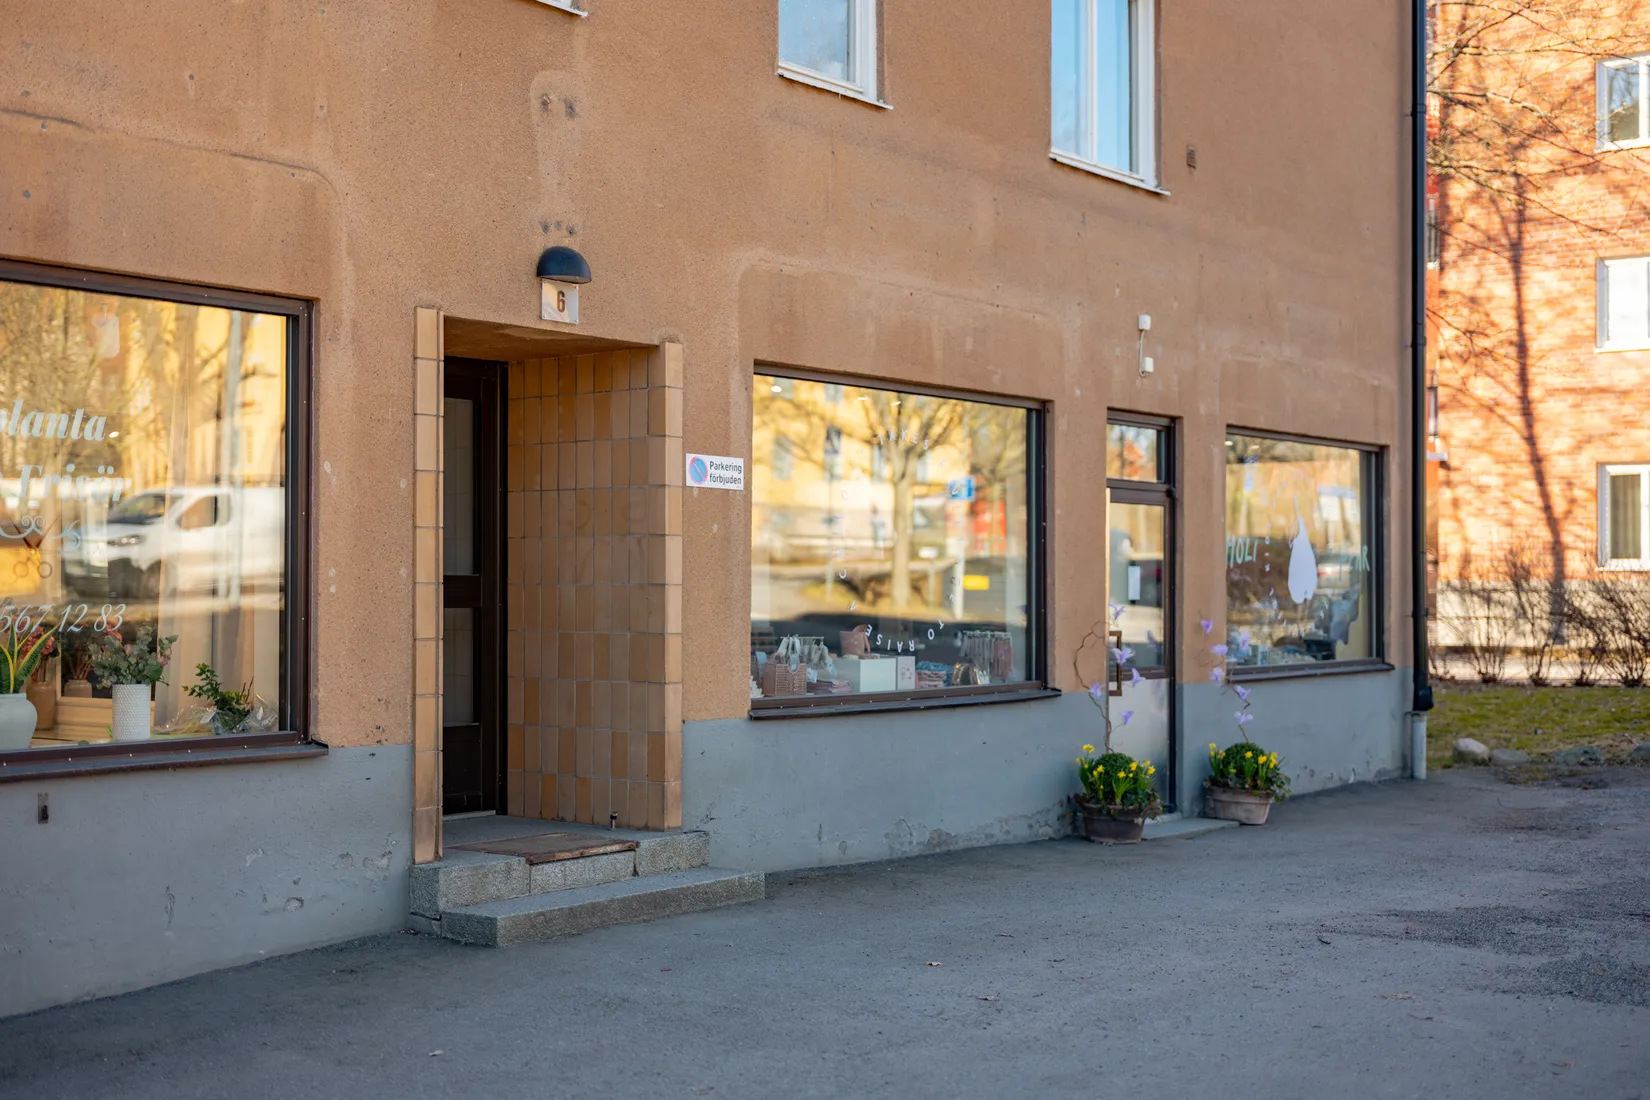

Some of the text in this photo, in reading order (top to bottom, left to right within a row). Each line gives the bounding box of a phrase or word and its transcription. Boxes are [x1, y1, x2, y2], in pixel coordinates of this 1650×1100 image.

[556, 290, 566, 313] 6
[709, 460, 743, 475] Parkering
[709, 472, 742, 486] förbjuden
[20, 463, 132, 502] Frisör
[0, 603, 127, 633] 567 12 83
[865, 624, 915, 653] RAISE
